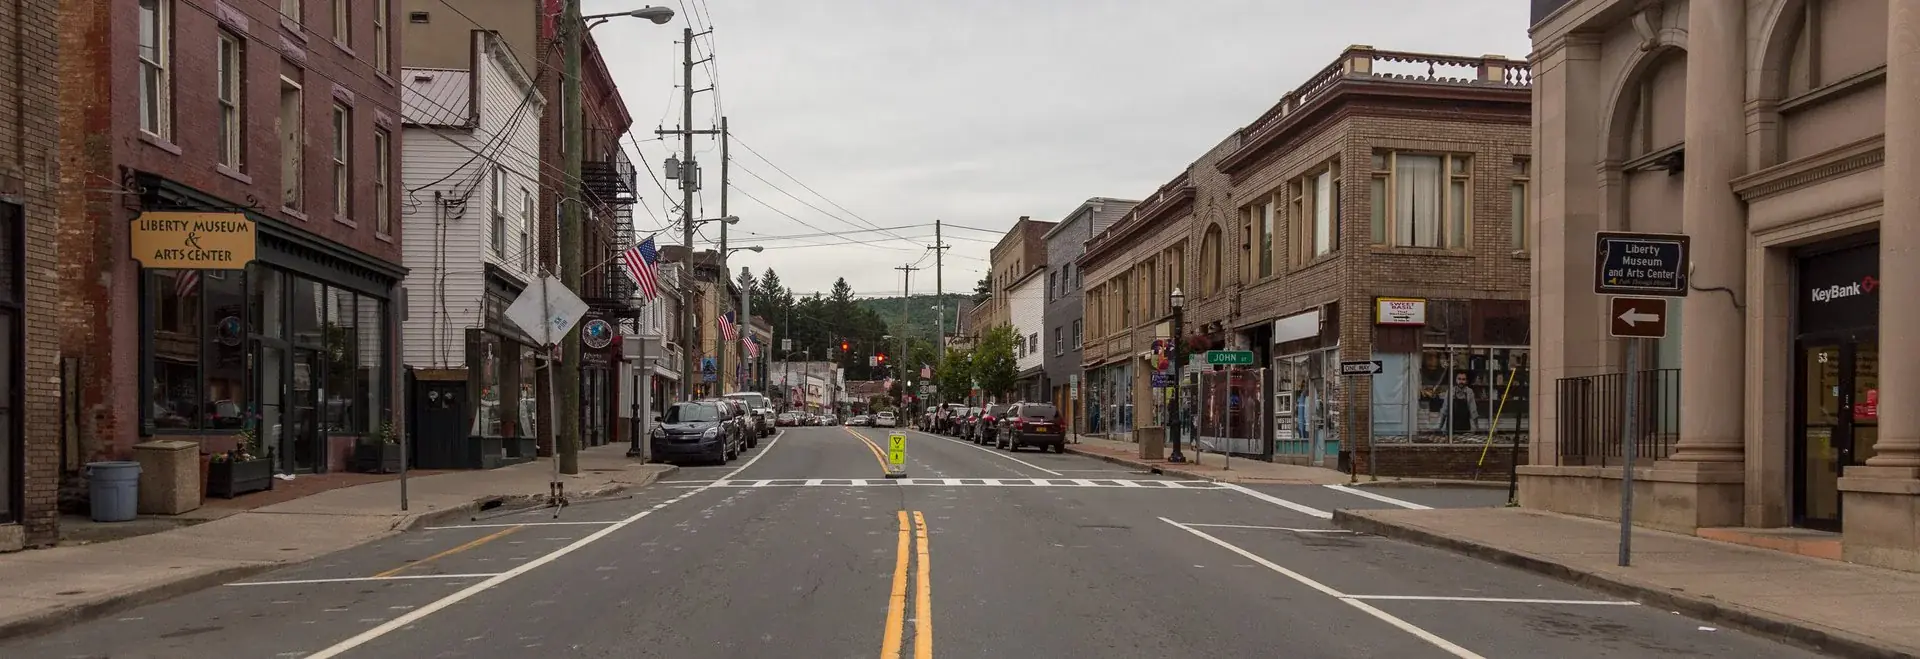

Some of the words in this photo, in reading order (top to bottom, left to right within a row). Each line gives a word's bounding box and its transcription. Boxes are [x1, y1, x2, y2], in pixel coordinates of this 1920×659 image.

[140, 220, 189, 231] LIBERTY
[193, 221, 249, 232] MUSEUM
[184, 231, 202, 250] &
[154, 248, 185, 260] ARTS
[187, 250, 232, 261] CENTER
[1625, 244, 1660, 256] Liberty
[1622, 256, 1662, 266] Museum
[1608, 268, 1623, 277] and
[1627, 268, 1645, 278] Arts
[1647, 269, 1674, 278] Center
[1811, 281, 1861, 302] KeyBank
[1213, 353, 1237, 362] JOHN
[1818, 352, 1828, 363] 53
